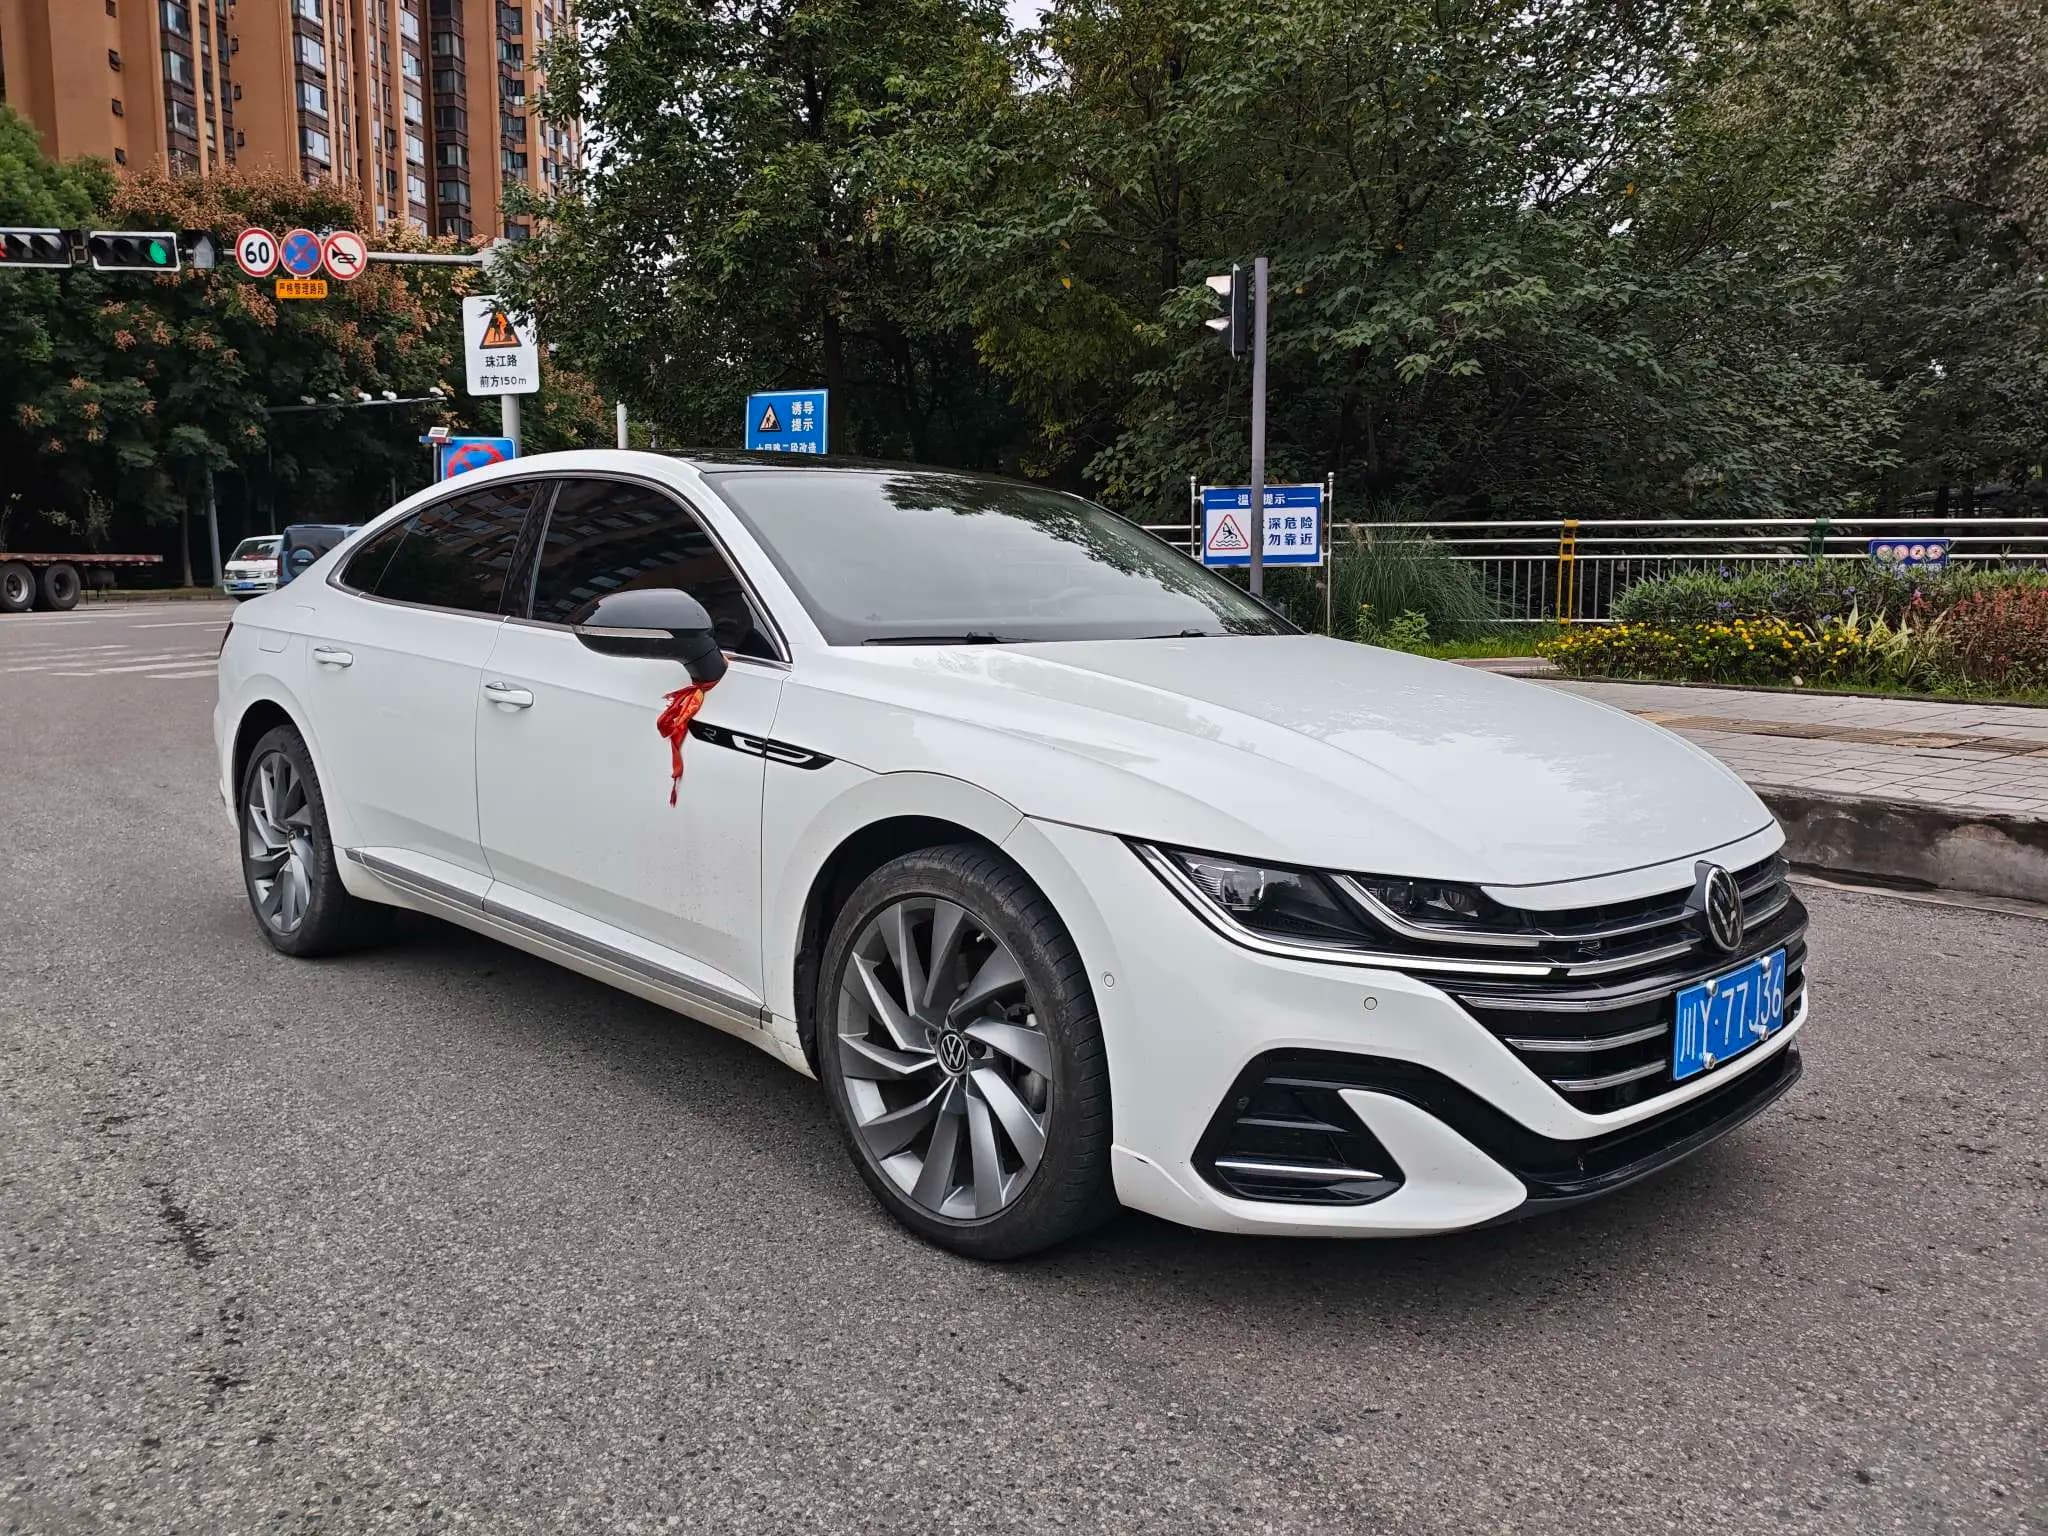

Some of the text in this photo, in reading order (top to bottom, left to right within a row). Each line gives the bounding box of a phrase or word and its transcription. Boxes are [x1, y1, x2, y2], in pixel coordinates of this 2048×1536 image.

[245, 241, 270, 264] 60
[485, 354, 517, 367] 珠江路
[480, 375, 527, 388] 前方150m
[791, 418, 814, 432] 提示
[1237, 493, 1286, 506] 温提示
[1262, 516, 1313, 530] 深危险
[1262, 533, 1313, 546] 勿靠近
